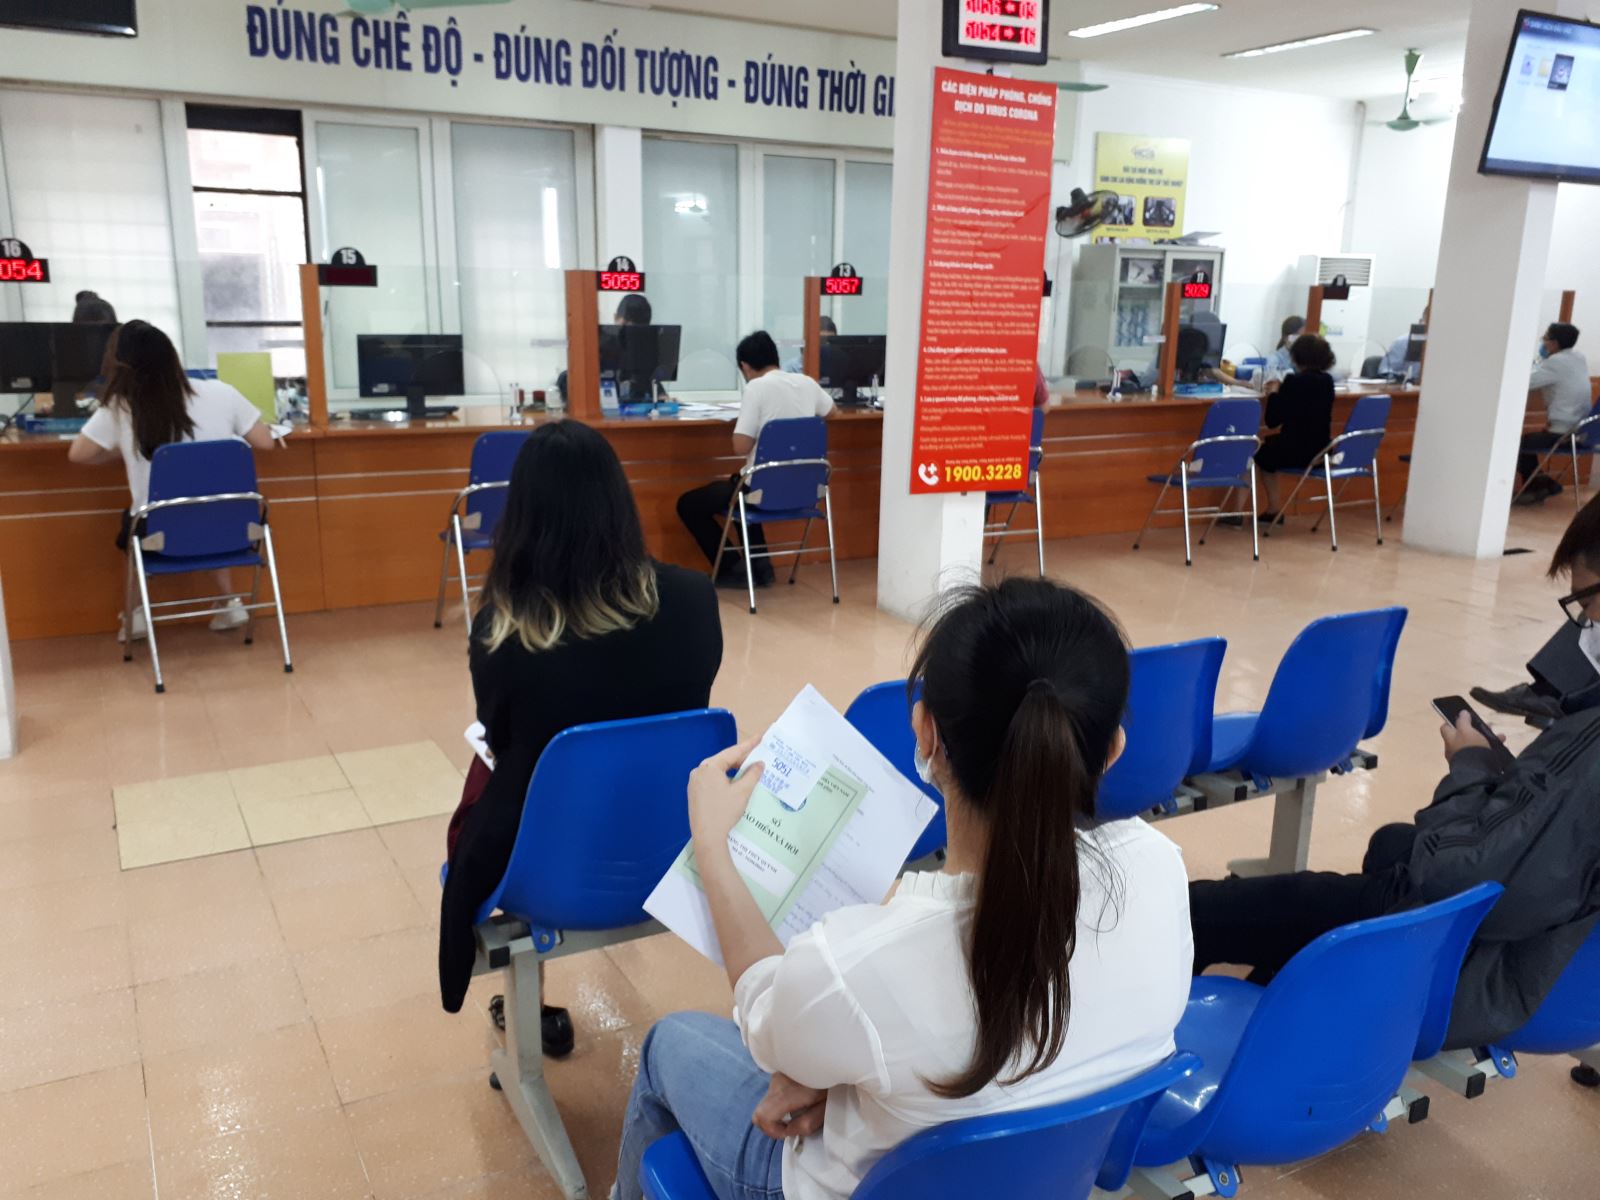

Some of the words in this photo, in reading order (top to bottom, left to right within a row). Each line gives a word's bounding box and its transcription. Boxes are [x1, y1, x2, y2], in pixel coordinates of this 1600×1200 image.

[246, 0, 340, 65] ĐÚNG
[422, 16, 462, 87] ĐỘ
[493, 25, 572, 86] ĐÚNG
[581, 28, 625, 91] ĐỐI
[635, 46, 718, 108] TƯỢNG
[744, 53, 809, 109] ĐÚNG
[817, 60, 866, 114] THỜI
[873, 74, 896, 117] GI
[1, 240, 21, 258] 16
[340, 249, 357, 265] 15
[601, 273, 640, 290] 5055
[826, 279, 859, 293] 5057
[944, 464, 1022, 482] 1900.3228
[771, 757, 792, 777] 5051
